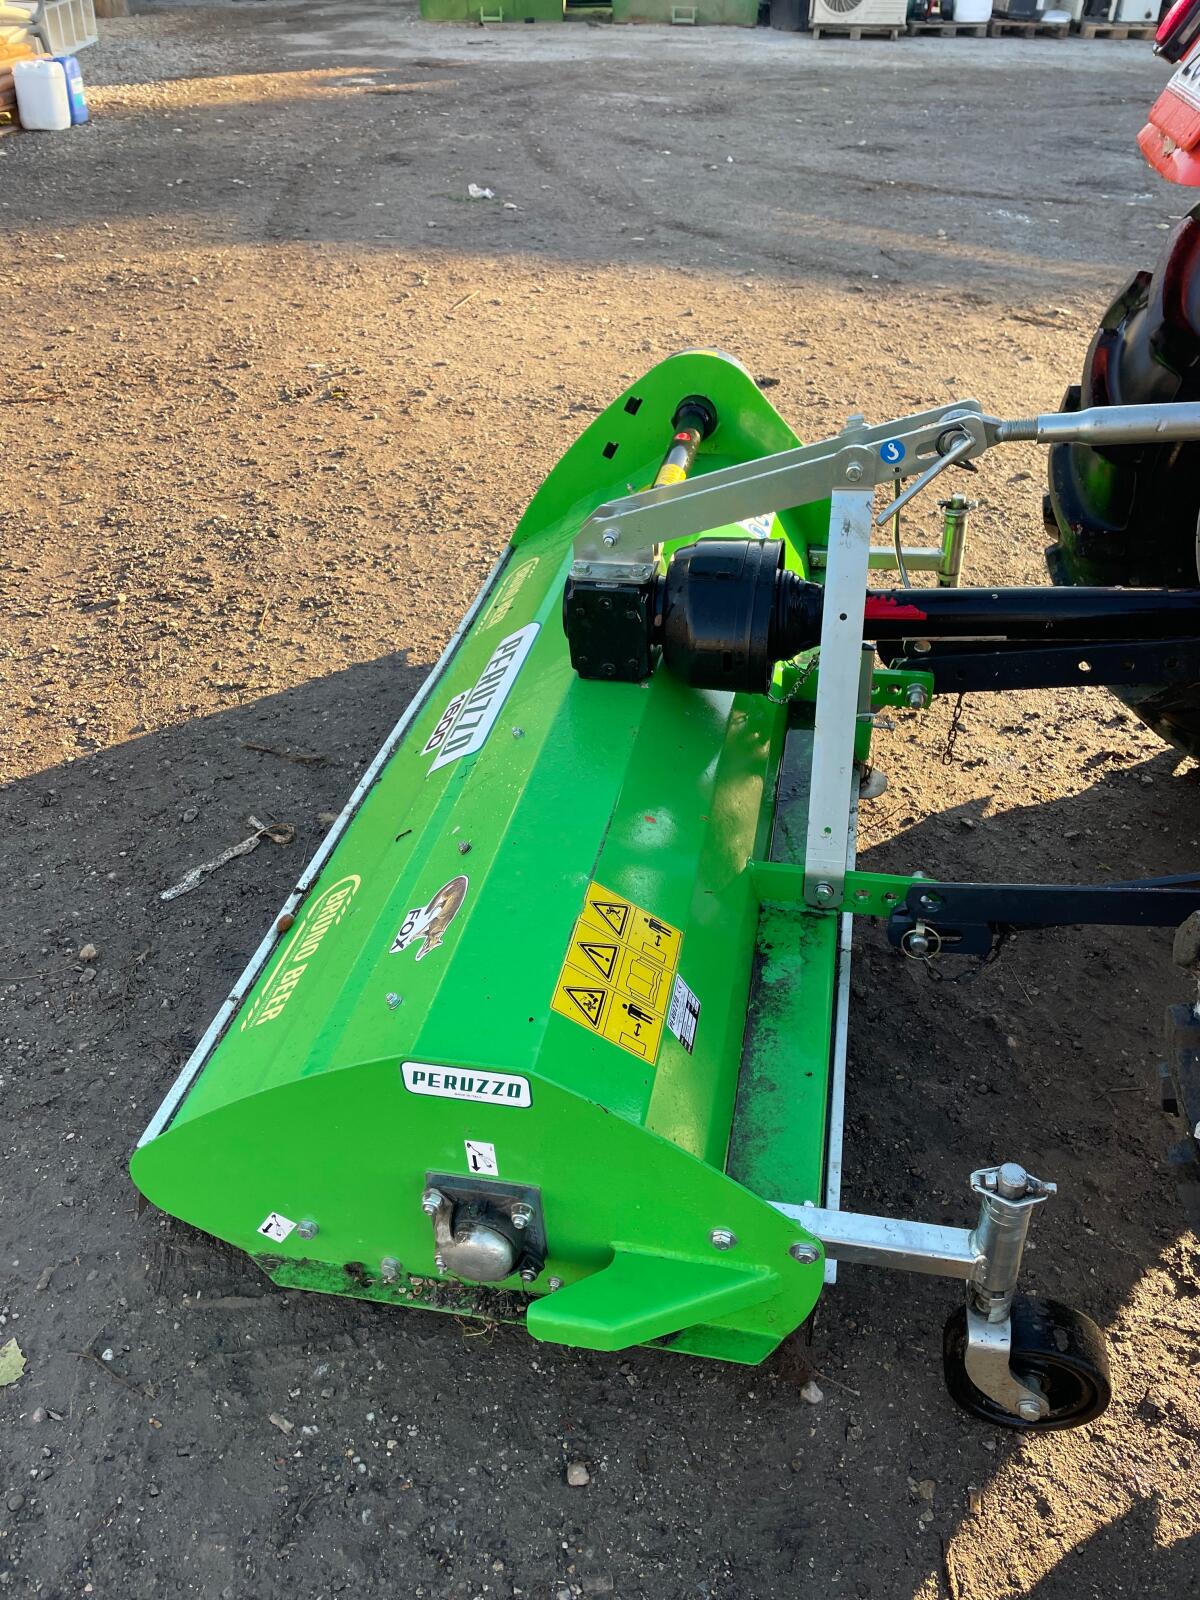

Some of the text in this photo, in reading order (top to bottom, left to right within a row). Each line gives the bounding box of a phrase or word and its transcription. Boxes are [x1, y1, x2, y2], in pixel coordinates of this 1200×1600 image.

[425, 694, 465, 751] 1600
[440, 635, 523, 757] PERUZZO
[294, 886, 353, 962] BRUNO
[391, 908, 421, 950] FOX
[255, 963, 308, 1026] BEER
[412, 1070, 522, 1099] PERUZZO
